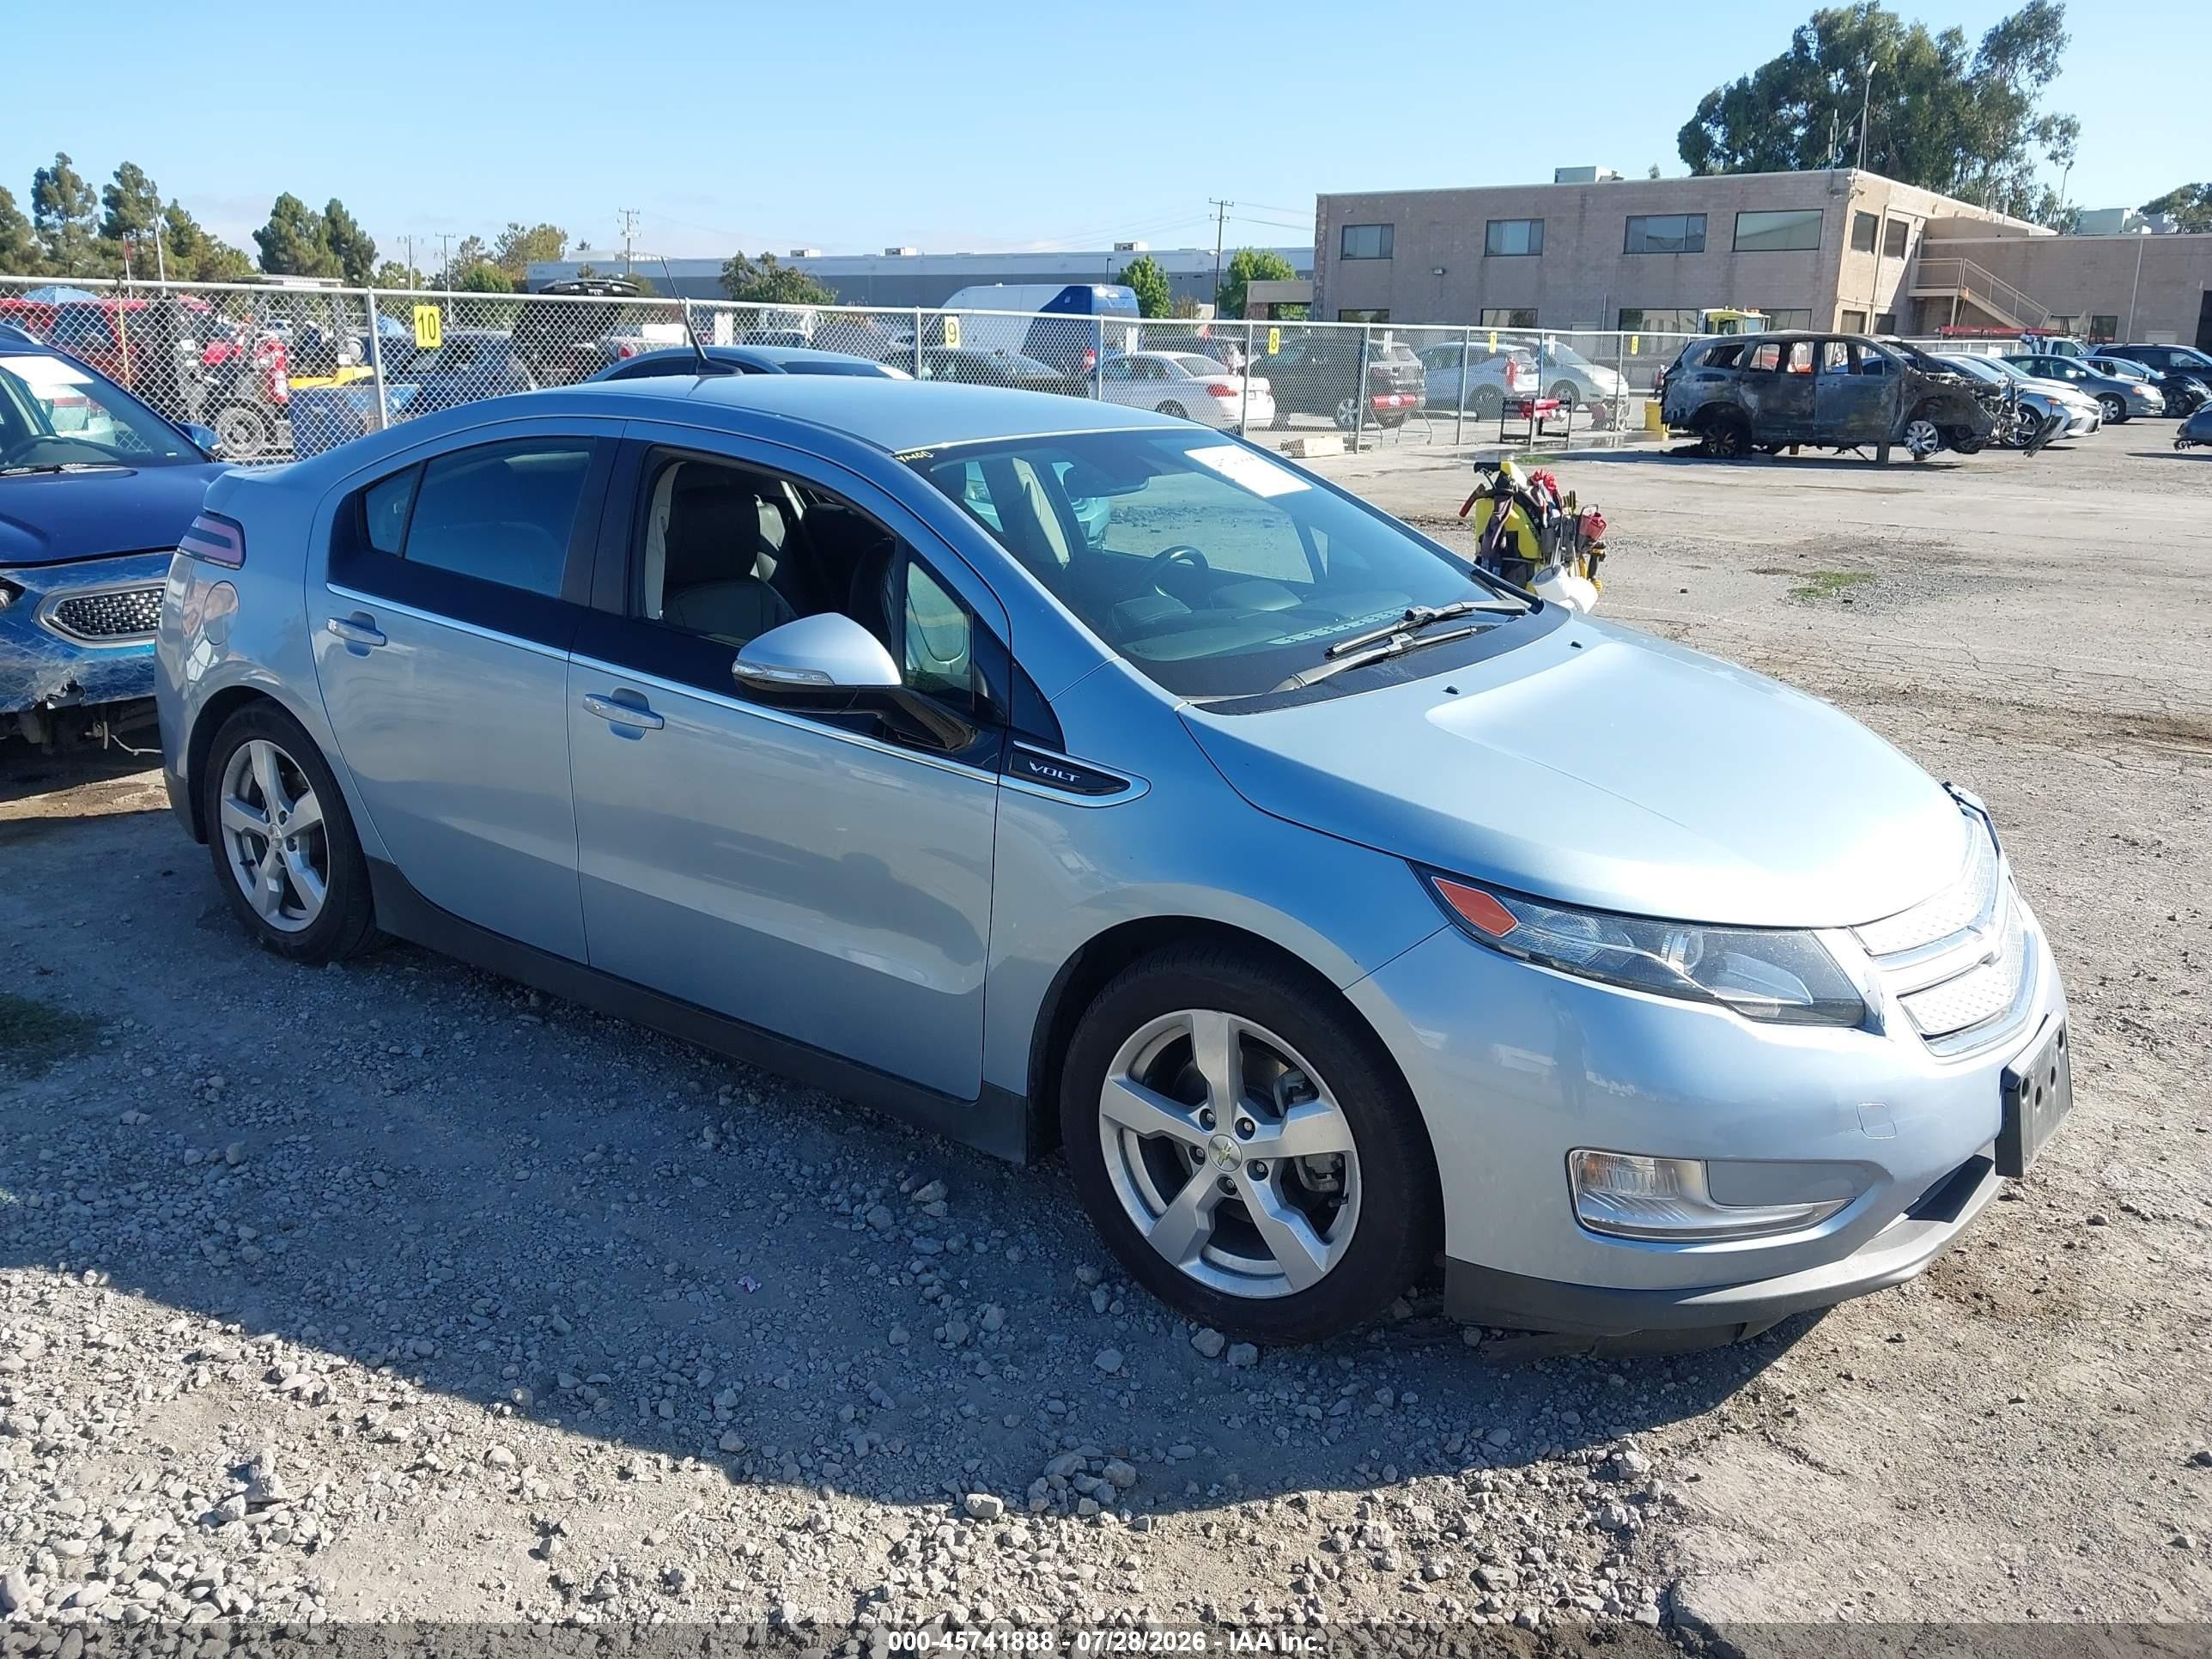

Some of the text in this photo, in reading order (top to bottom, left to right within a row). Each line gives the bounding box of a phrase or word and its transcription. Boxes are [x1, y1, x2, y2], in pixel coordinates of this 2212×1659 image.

[418, 313, 436, 340] 10
[947, 322, 957, 343] 9
[1271, 332, 1278, 349] 8
[1030, 760, 1080, 782] VOLT
